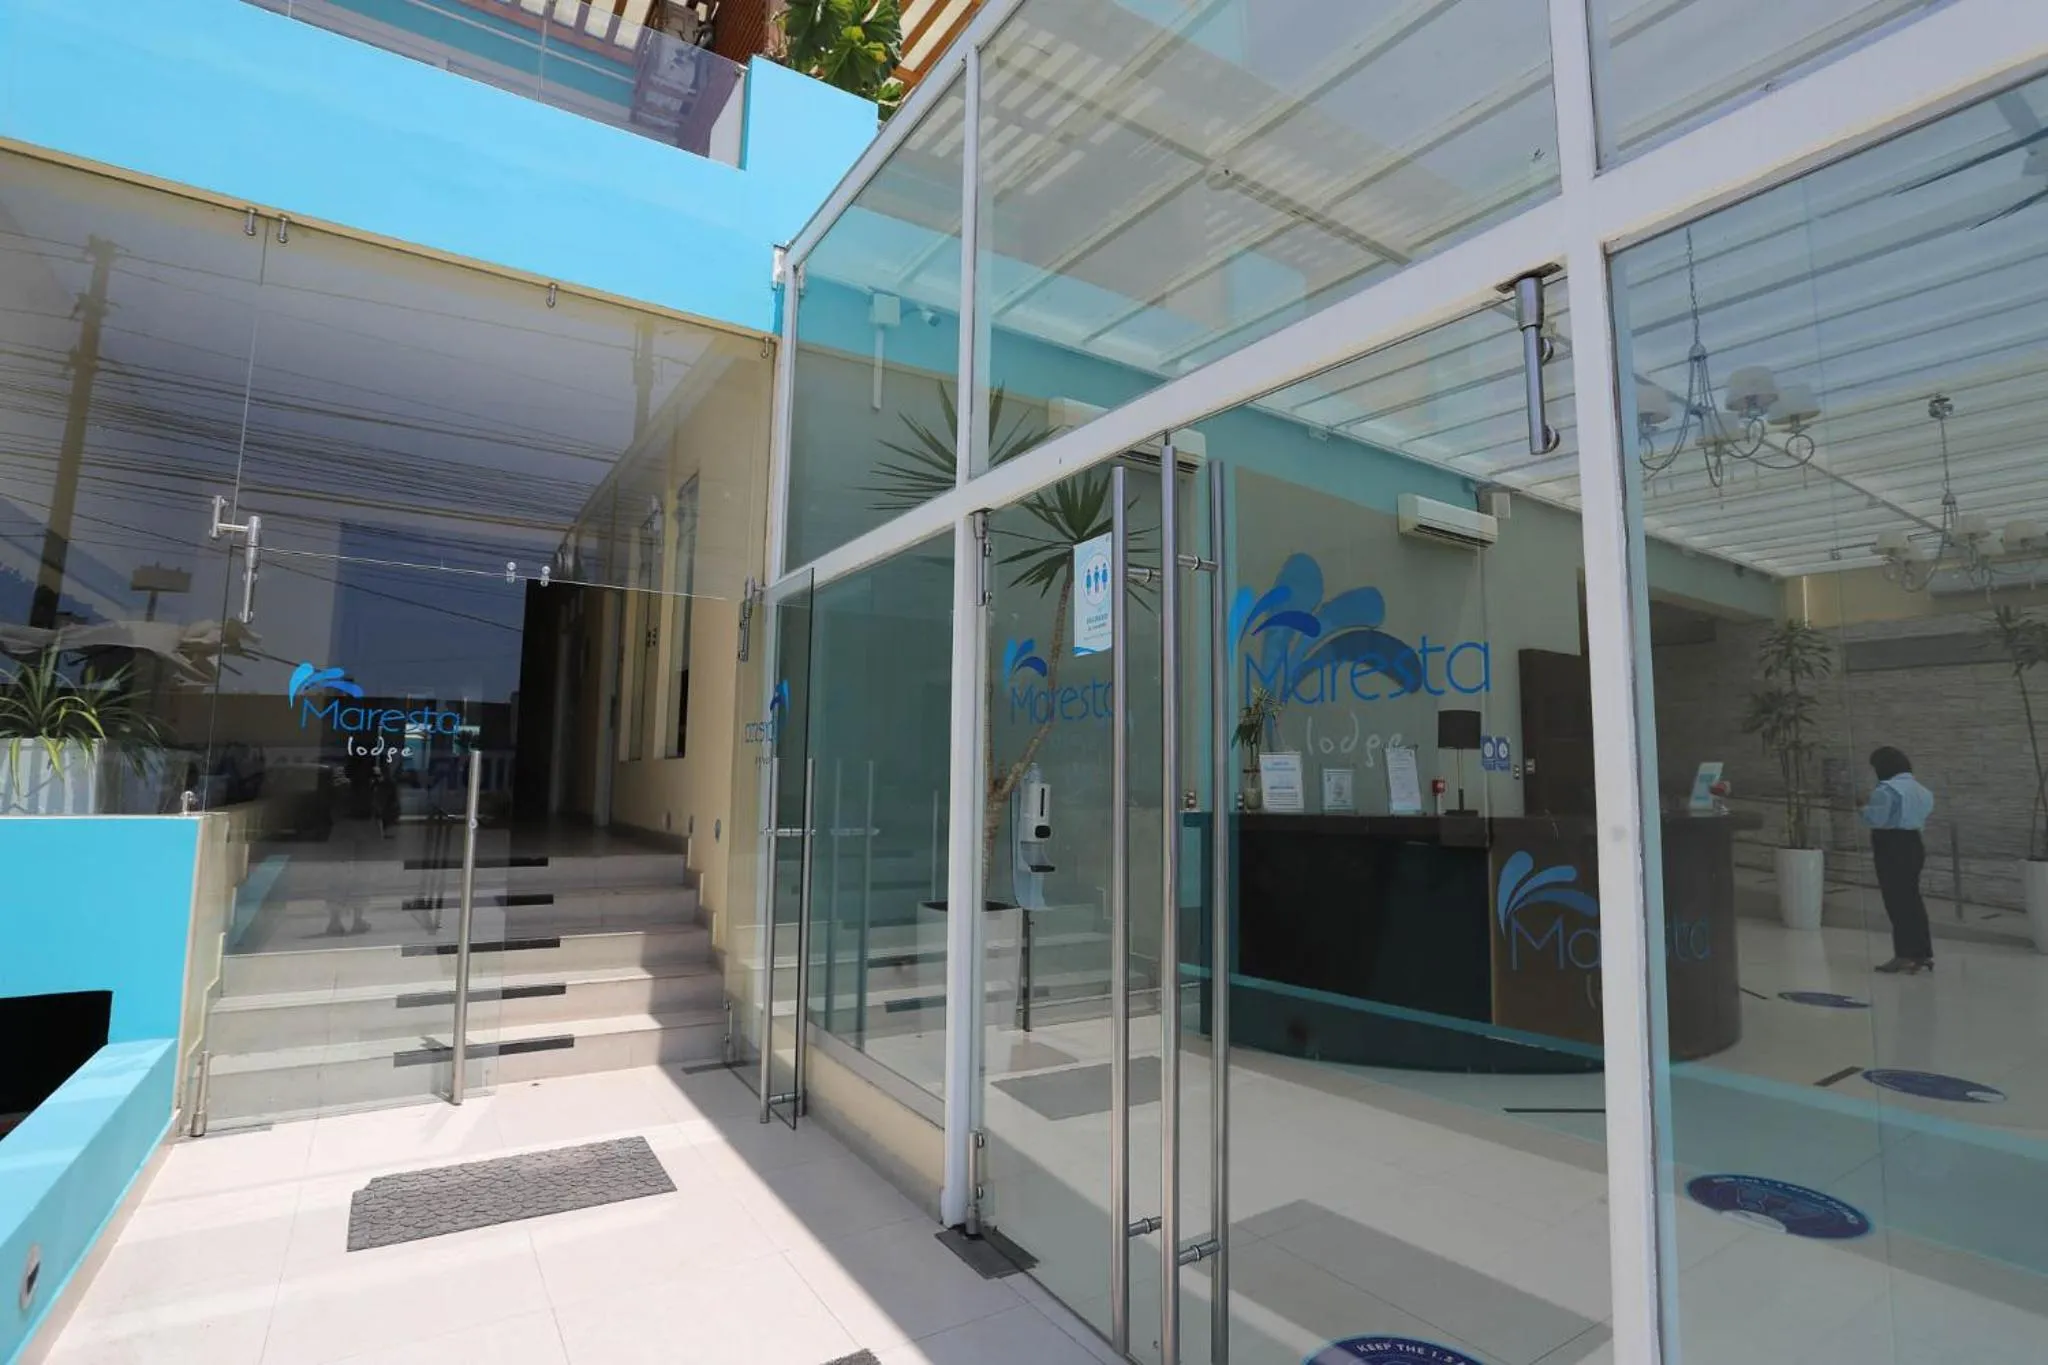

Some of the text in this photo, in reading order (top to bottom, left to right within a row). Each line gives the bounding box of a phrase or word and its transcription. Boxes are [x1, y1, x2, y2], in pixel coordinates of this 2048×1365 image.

[1244, 635, 1492, 705] Maresta
[302, 698, 460, 734] Maresta
[1306, 711, 1405, 767] lodge
[348, 737, 414, 764] lodge
[1510, 912, 1712, 971] Mata
[1355, 1343, 1392, 1353] KEEP
[1398, 1344, 1425, 1354] THE
